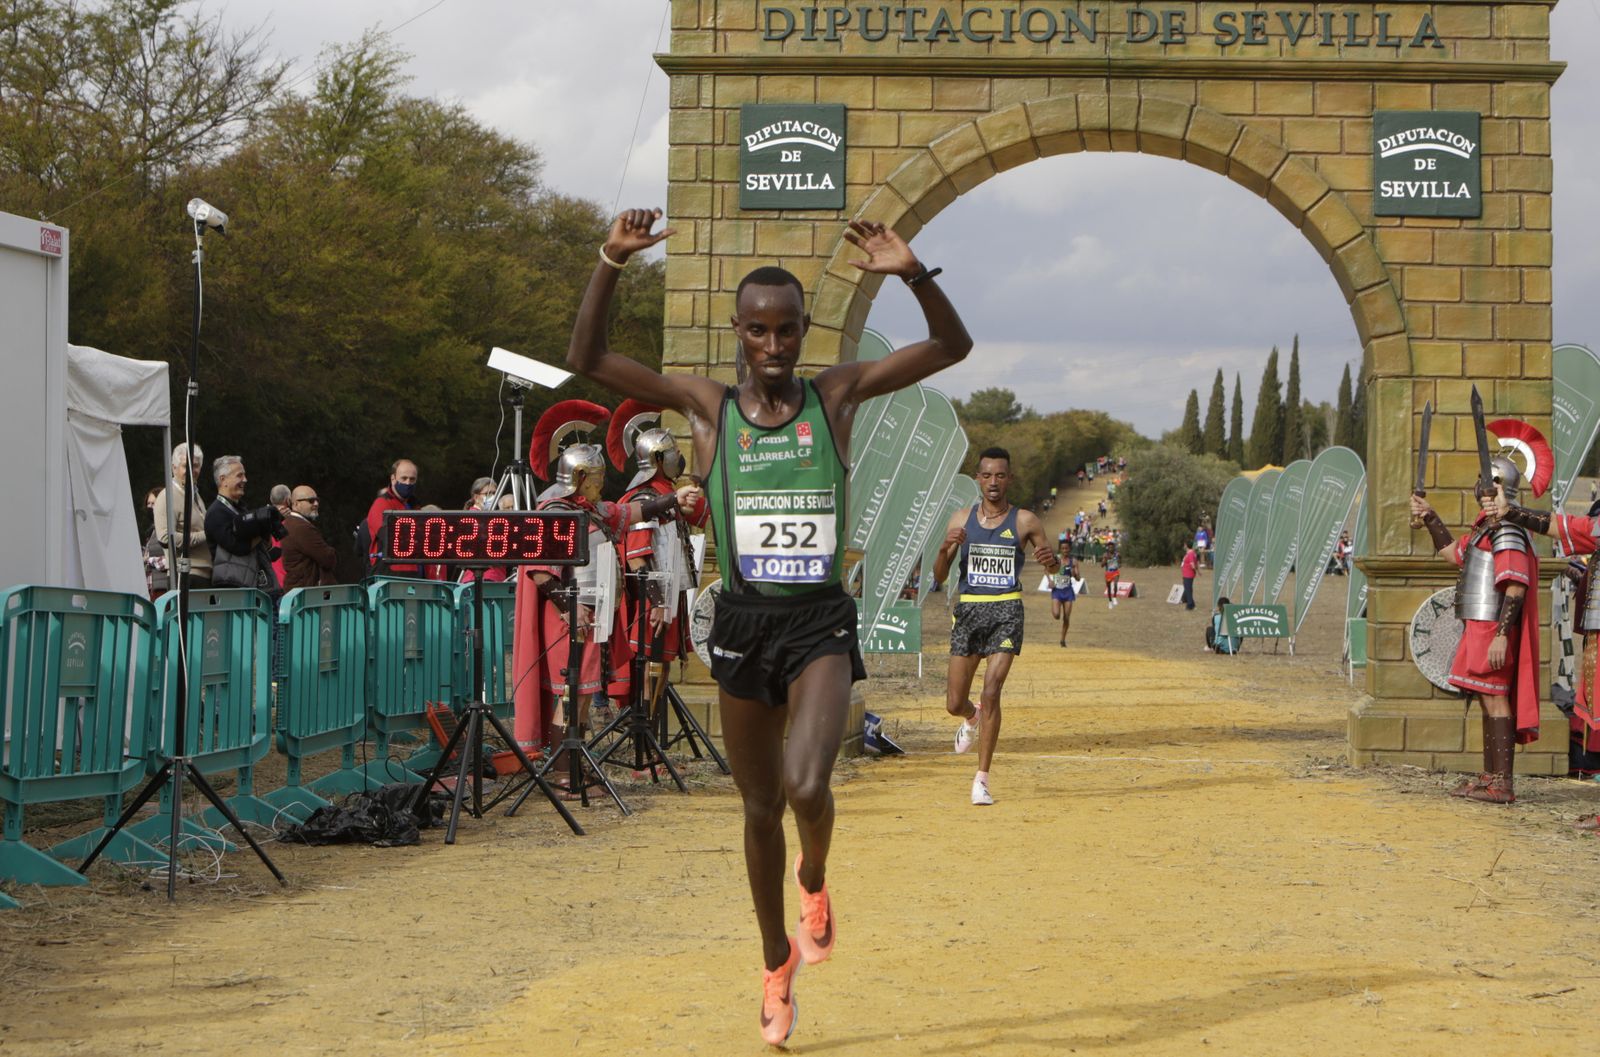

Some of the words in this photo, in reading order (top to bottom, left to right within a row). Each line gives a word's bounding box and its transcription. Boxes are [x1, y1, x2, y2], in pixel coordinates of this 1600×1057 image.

[763, 6, 1100, 43] DIPUTACION
[1126, 8, 1186, 44] DE
[1214, 10, 1445, 48] SEVILLA
[744, 120, 842, 147] DIPUTACION
[1377, 128, 1476, 154] DIPUTACION
[780, 150, 802, 162] DE
[1414, 159, 1437, 171] DE
[746, 173, 835, 190] SEVILLA
[1380, 181, 1471, 198] SEVILLA
[739, 449, 796, 463] VILLARREAL
[736, 496, 791, 509] DIPUTACION
[793, 496, 805, 509] DE
[806, 495, 835, 509] SEVILLA
[393, 517, 576, 558] 00:28:34
[759, 522, 818, 548] 252
[751, 558, 825, 577] Joma
[972, 557, 1012, 574] WORKU
[875, 552, 900, 598] CROSS
[1271, 566, 1289, 595] CROSS
[1304, 564, 1322, 600] CROSS
[1233, 607, 1279, 619] DIPUTACION
[1237, 627, 1280, 635] SEVILLA
